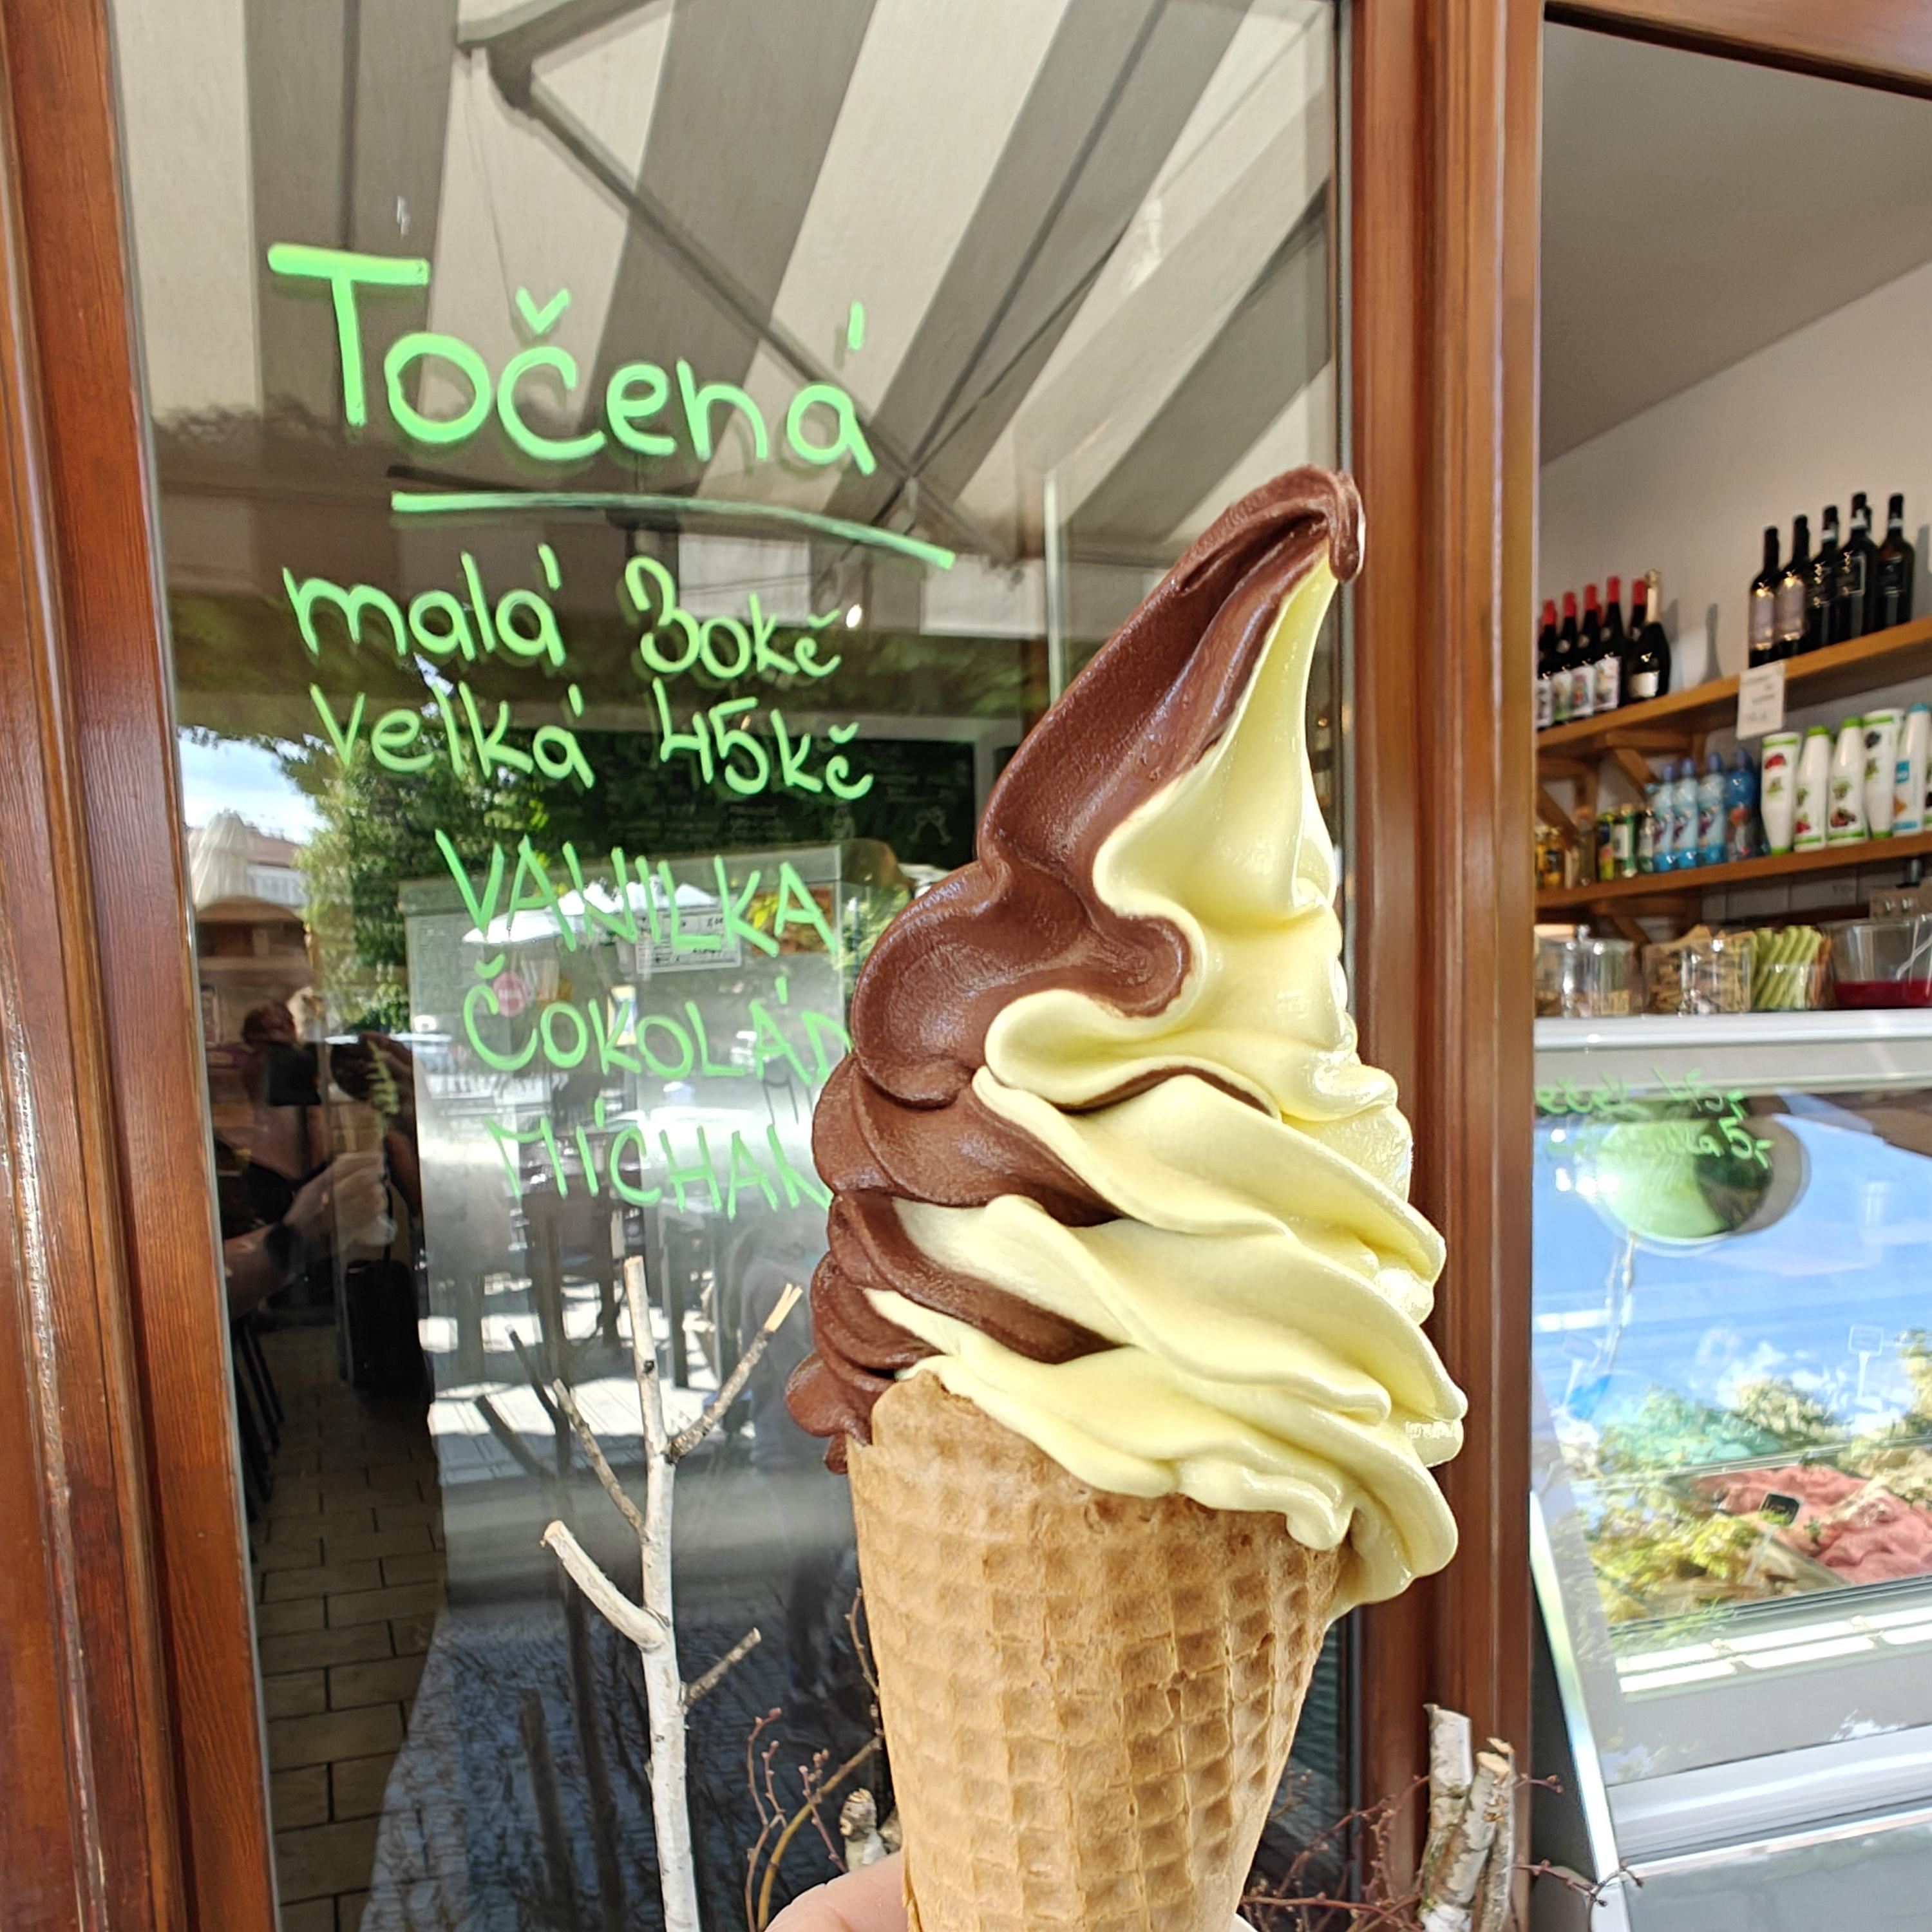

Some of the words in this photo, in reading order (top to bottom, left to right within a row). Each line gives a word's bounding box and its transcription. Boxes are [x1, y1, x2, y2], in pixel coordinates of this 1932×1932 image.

[267, 244, 875, 475] Točená
[283, 544, 565, 667] malá
[435, 829, 839, 958] VANILKA
